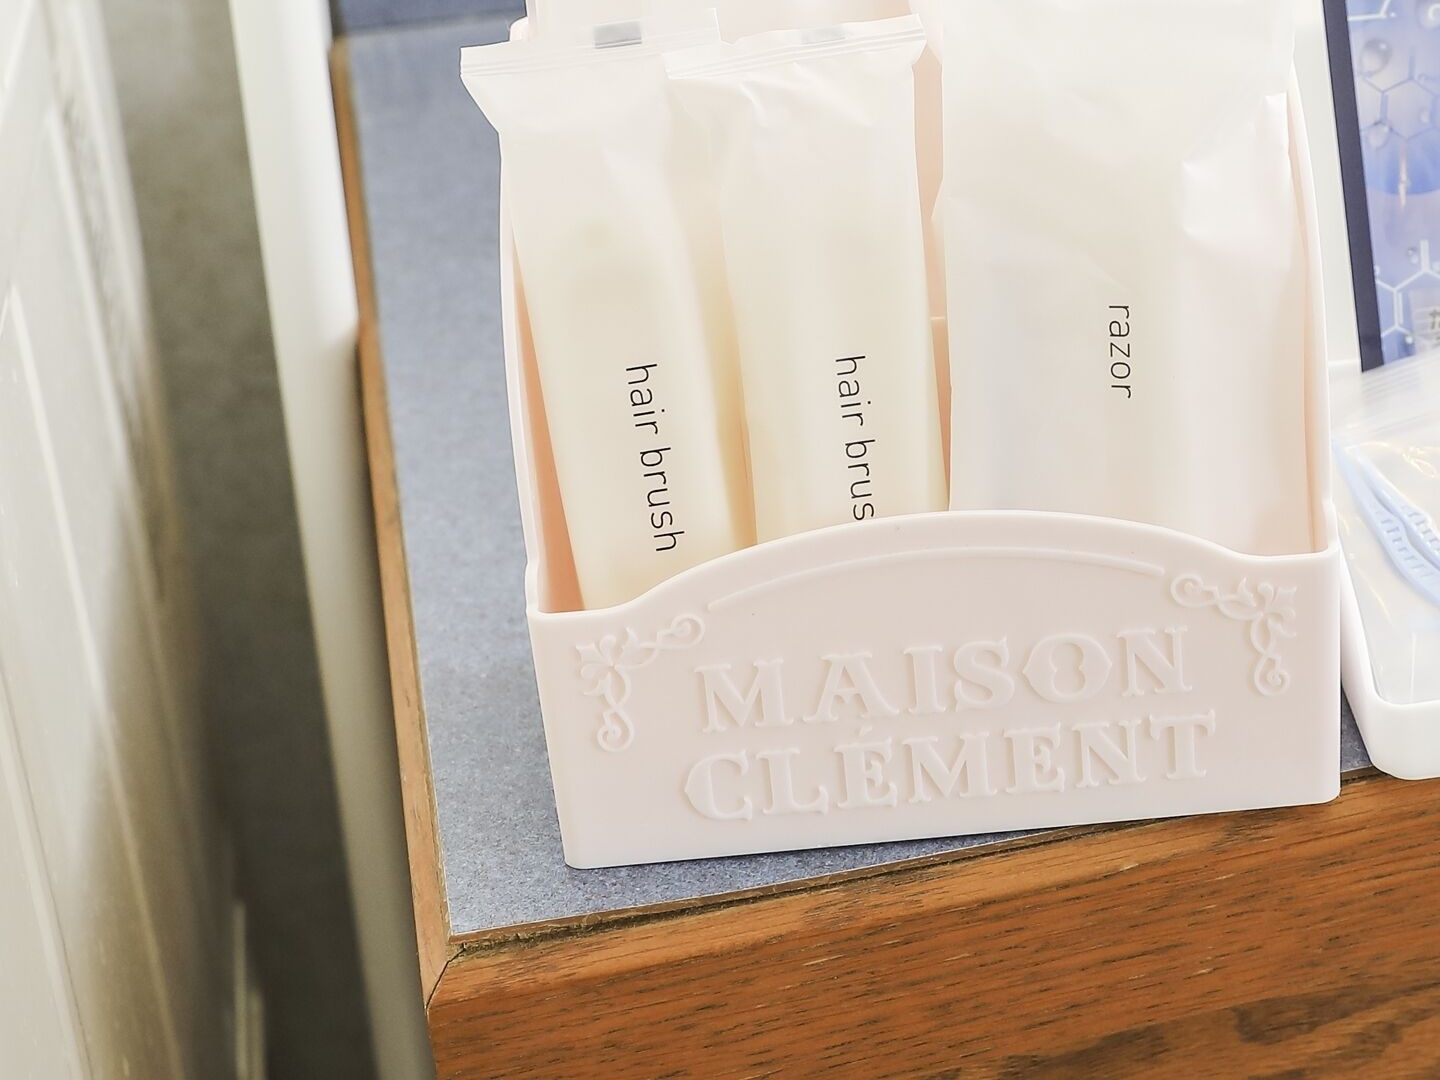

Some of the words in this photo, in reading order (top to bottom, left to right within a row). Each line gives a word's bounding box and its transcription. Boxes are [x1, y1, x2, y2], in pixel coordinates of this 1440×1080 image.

[626, 363, 665, 434] hair
[835, 355, 871, 426] hair
[1108, 305, 1131, 399] razor
[639, 447, 685, 551] brush
[694, 625, 1192, 734] MAISON
[685, 708, 1216, 821] CLÉMENT
